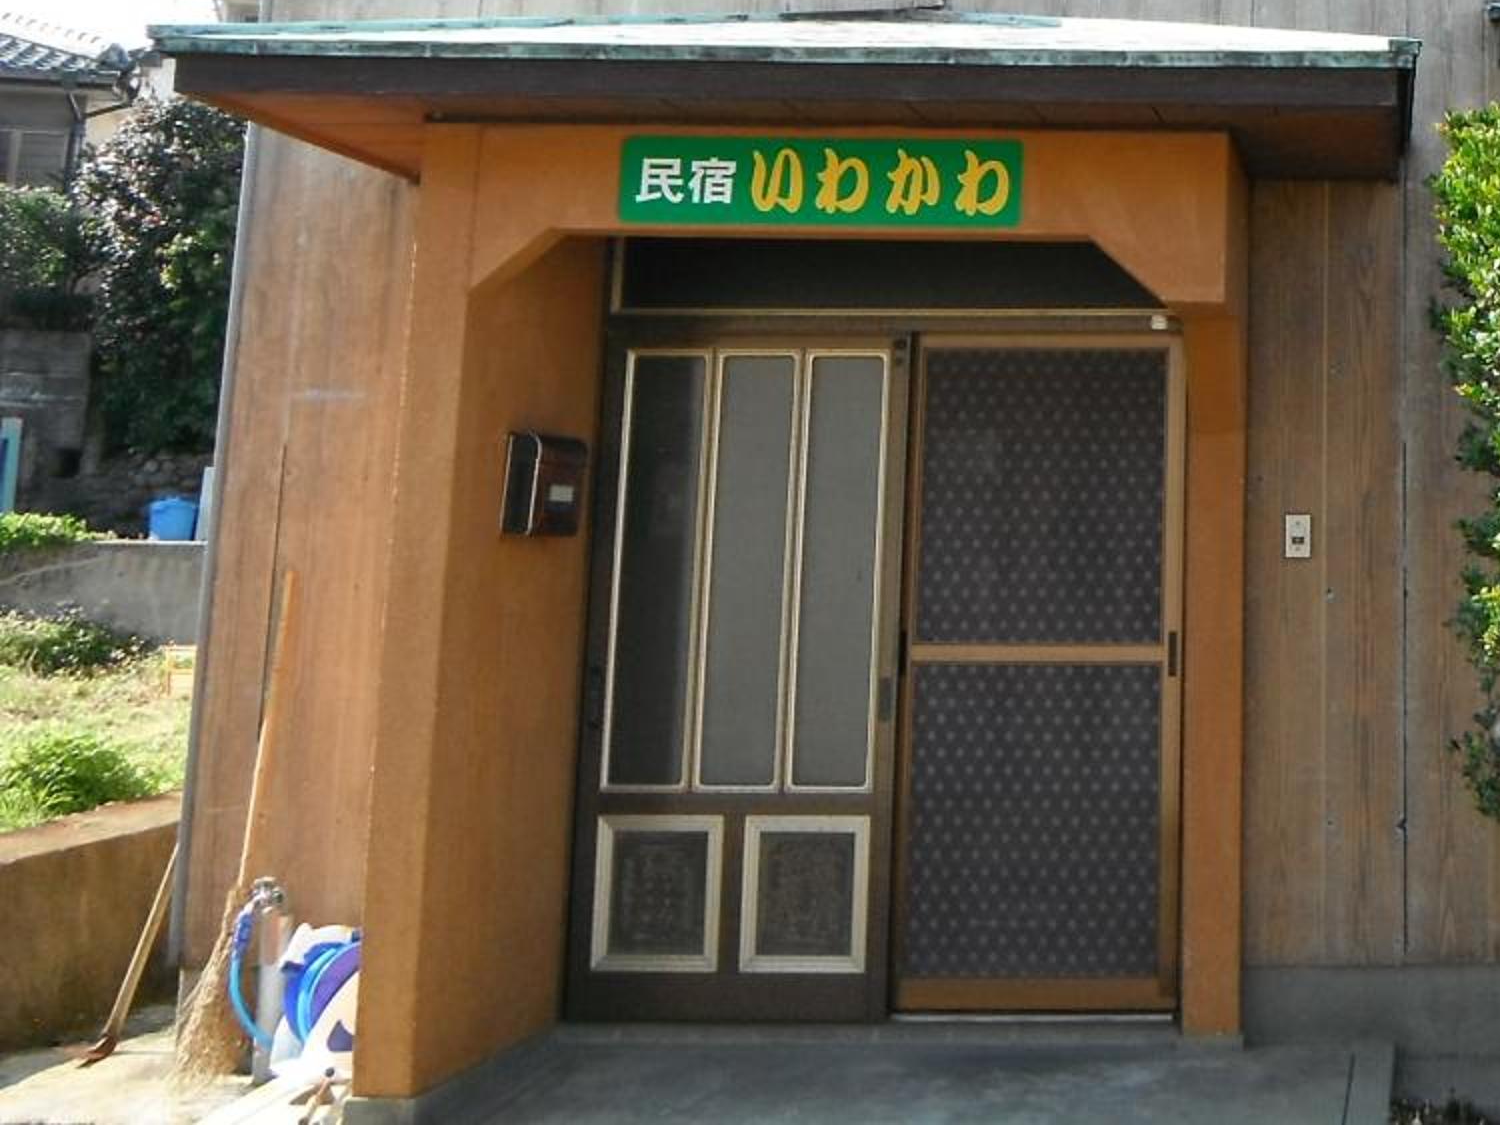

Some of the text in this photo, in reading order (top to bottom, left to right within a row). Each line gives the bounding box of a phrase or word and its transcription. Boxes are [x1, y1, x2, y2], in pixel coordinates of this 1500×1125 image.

[635, 147, 1010, 216] 民宿 いわかわ
